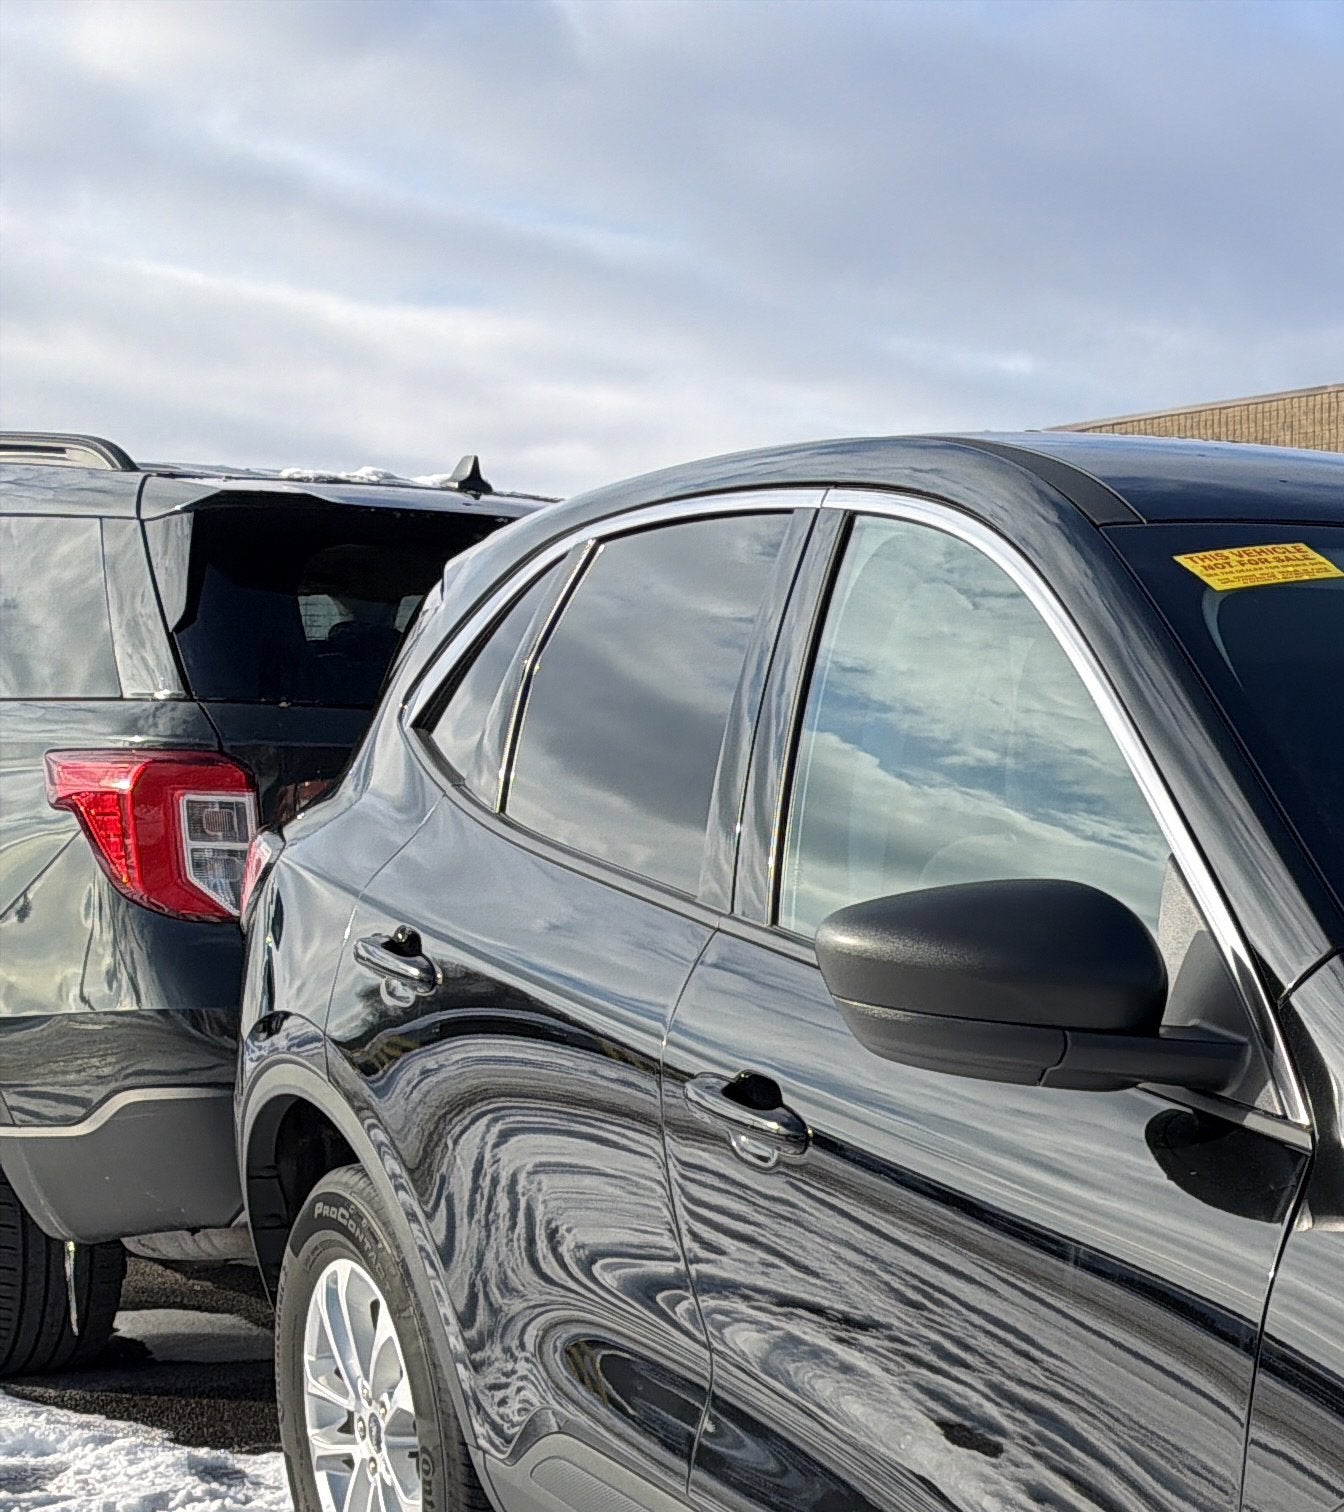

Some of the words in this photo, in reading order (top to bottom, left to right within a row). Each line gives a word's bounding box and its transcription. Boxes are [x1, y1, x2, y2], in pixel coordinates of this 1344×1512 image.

[1183, 552, 1231, 565] THIS
[1229, 545, 1309, 559] VEHICLE
[1201, 561, 1235, 572] NOT
[1237, 557, 1271, 567] FOR
[1272, 554, 1316, 563] SALE
